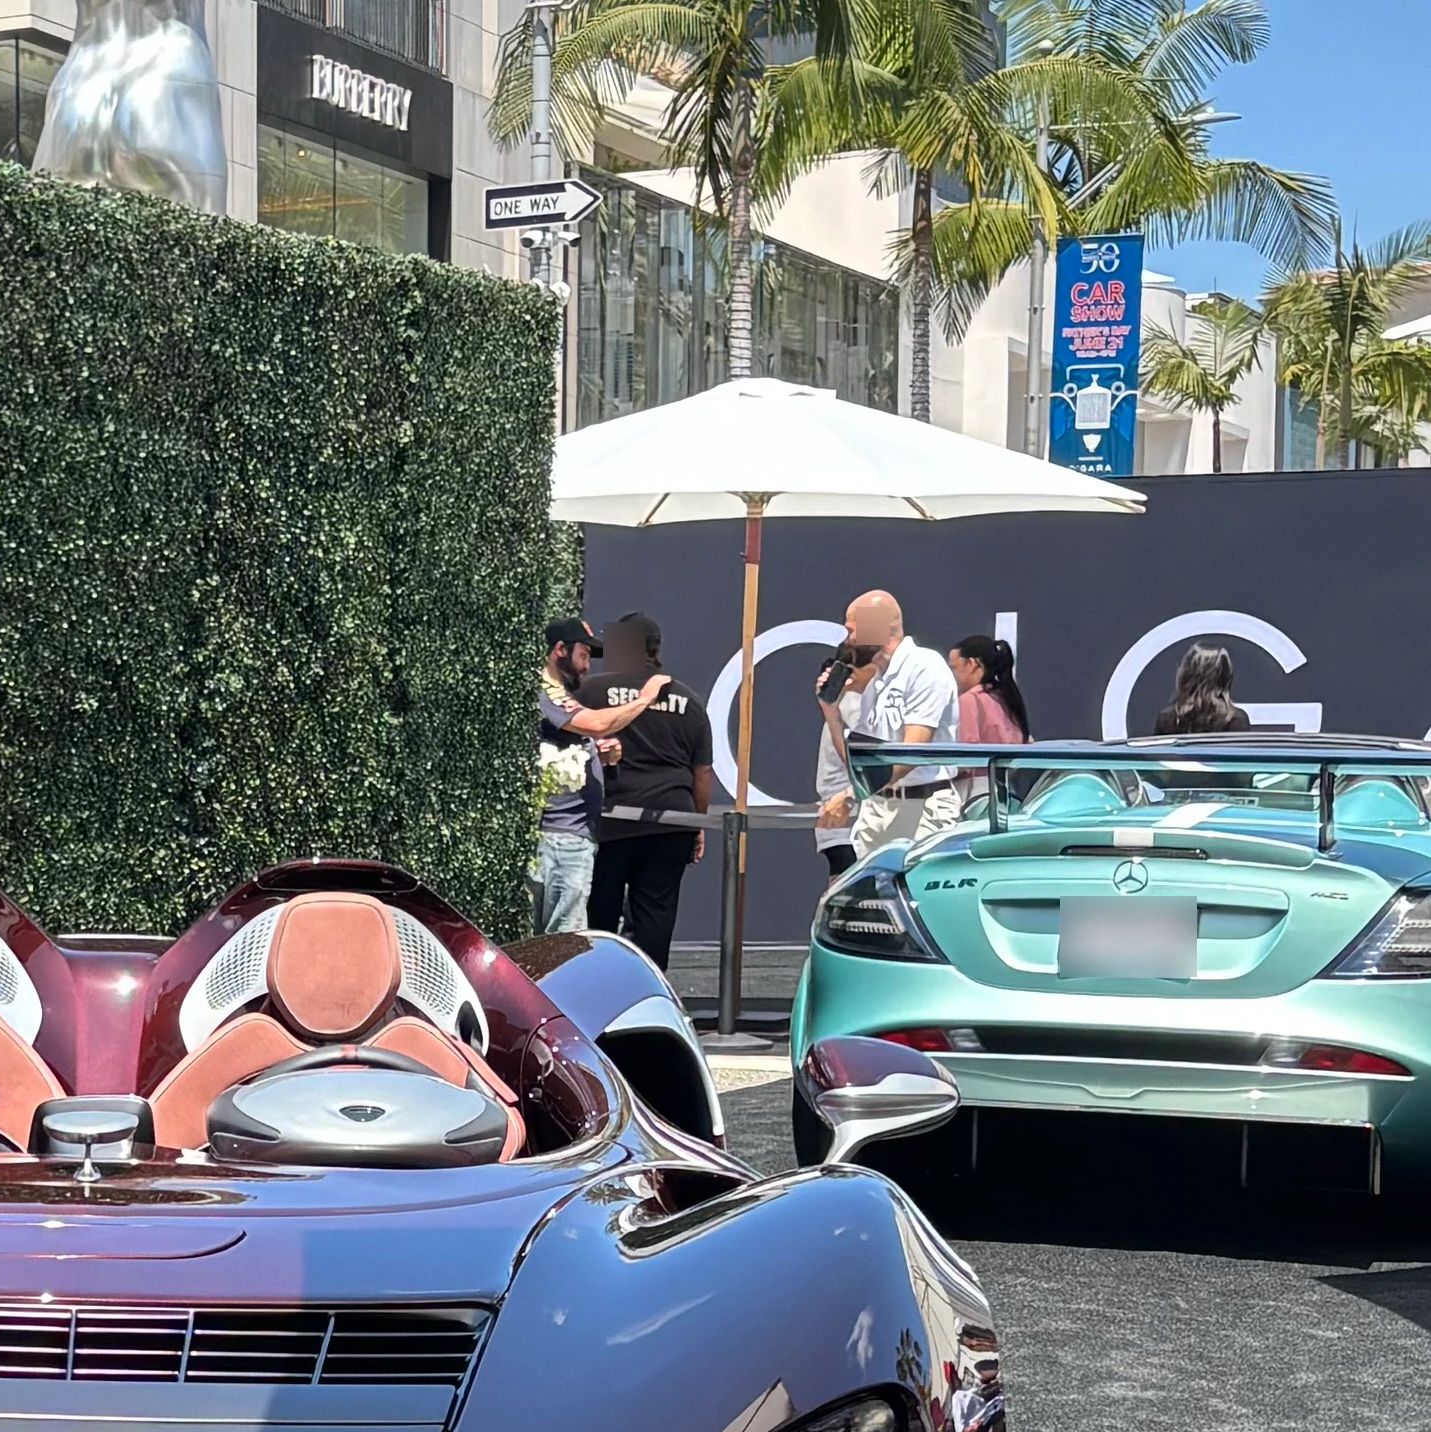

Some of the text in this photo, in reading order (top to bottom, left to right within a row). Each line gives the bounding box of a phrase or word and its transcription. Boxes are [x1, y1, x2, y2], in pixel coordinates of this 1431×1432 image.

[493, 195, 561, 217] ONE WAY
[1070, 281, 1126, 306] CAR
[1070, 304, 1126, 323] SHOW
[607, 686, 689, 715] SECTY
